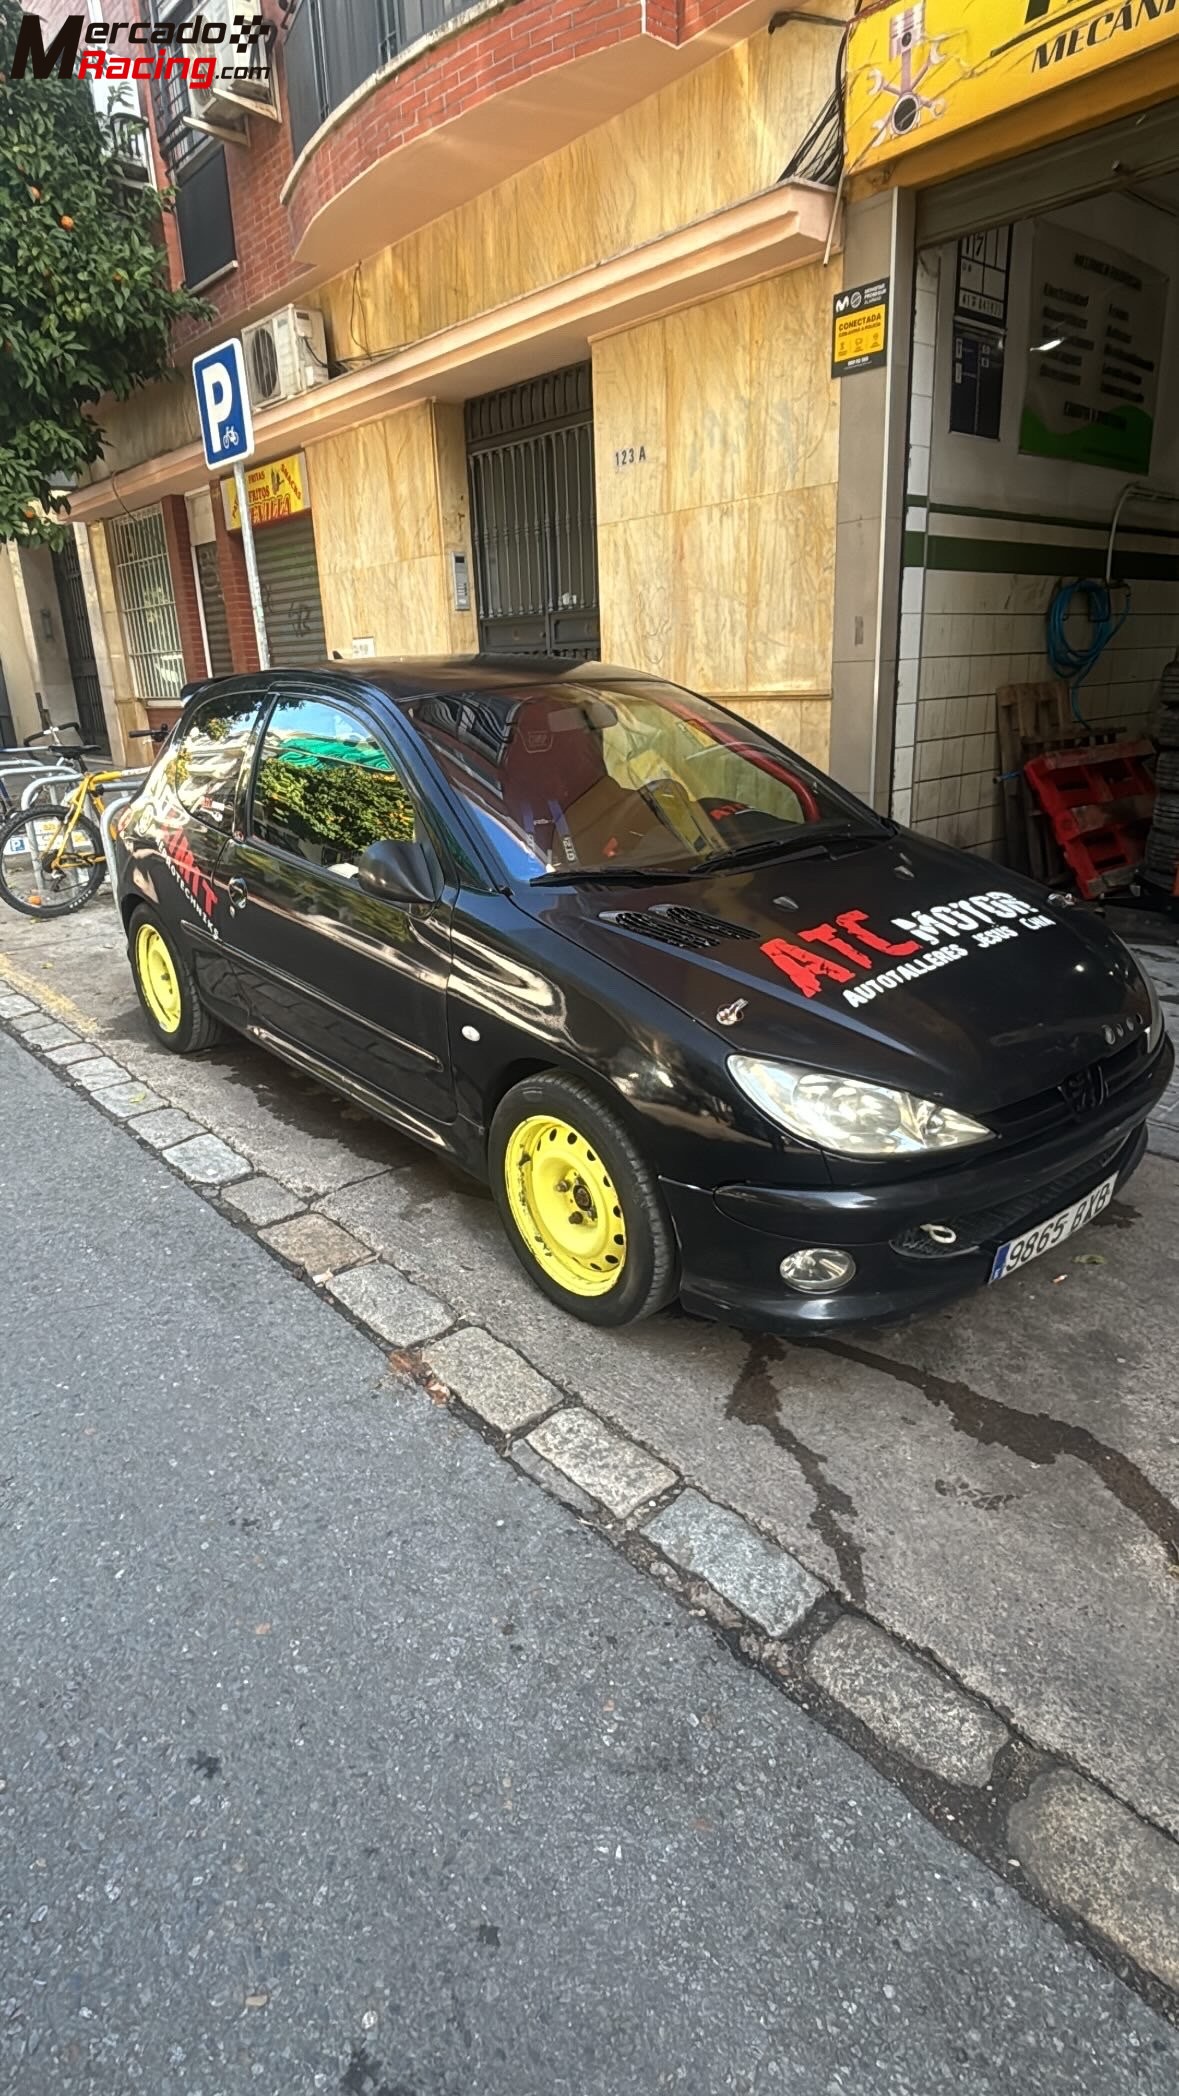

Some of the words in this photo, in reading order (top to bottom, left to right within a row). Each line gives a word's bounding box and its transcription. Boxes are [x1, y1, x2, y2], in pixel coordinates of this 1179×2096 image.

[838, 312, 881, 331] CONECTADA
[201, 362, 233, 453] P
[615, 448, 635, 466] 123
[639, 446, 647, 461] A
[760, 910, 924, 998] ATC
[890, 892, 1040, 945] MOTOR
[842, 944, 969, 1008] AUTOTALLERES
[1006, 1213, 1070, 1271] 9865
[1071, 1183, 1110, 1232] BXB
